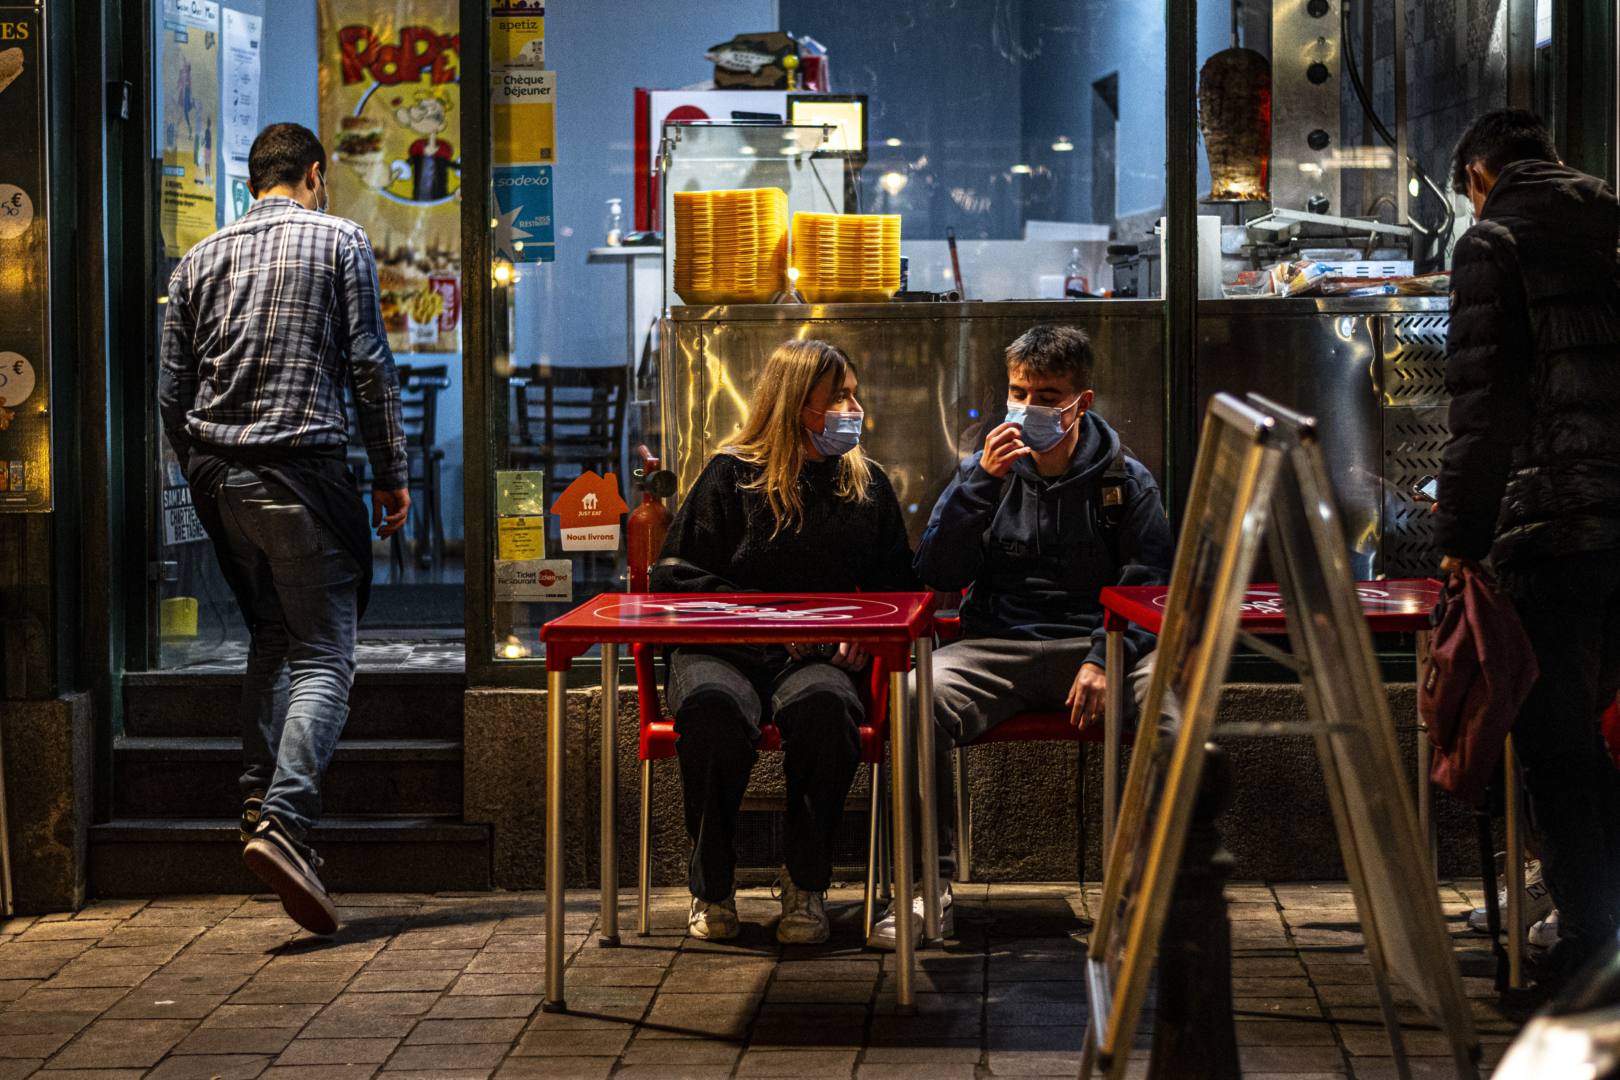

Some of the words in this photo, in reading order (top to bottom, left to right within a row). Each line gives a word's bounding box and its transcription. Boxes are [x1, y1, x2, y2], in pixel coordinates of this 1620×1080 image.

[499, 20, 538, 32] apetiz
[503, 75, 544, 86] Chèque
[504, 85, 551, 97] Déjeuner
[497, 175, 549, 186] sodexo
[566, 533, 586, 541] Nous
[587, 532, 614, 541] livrons
